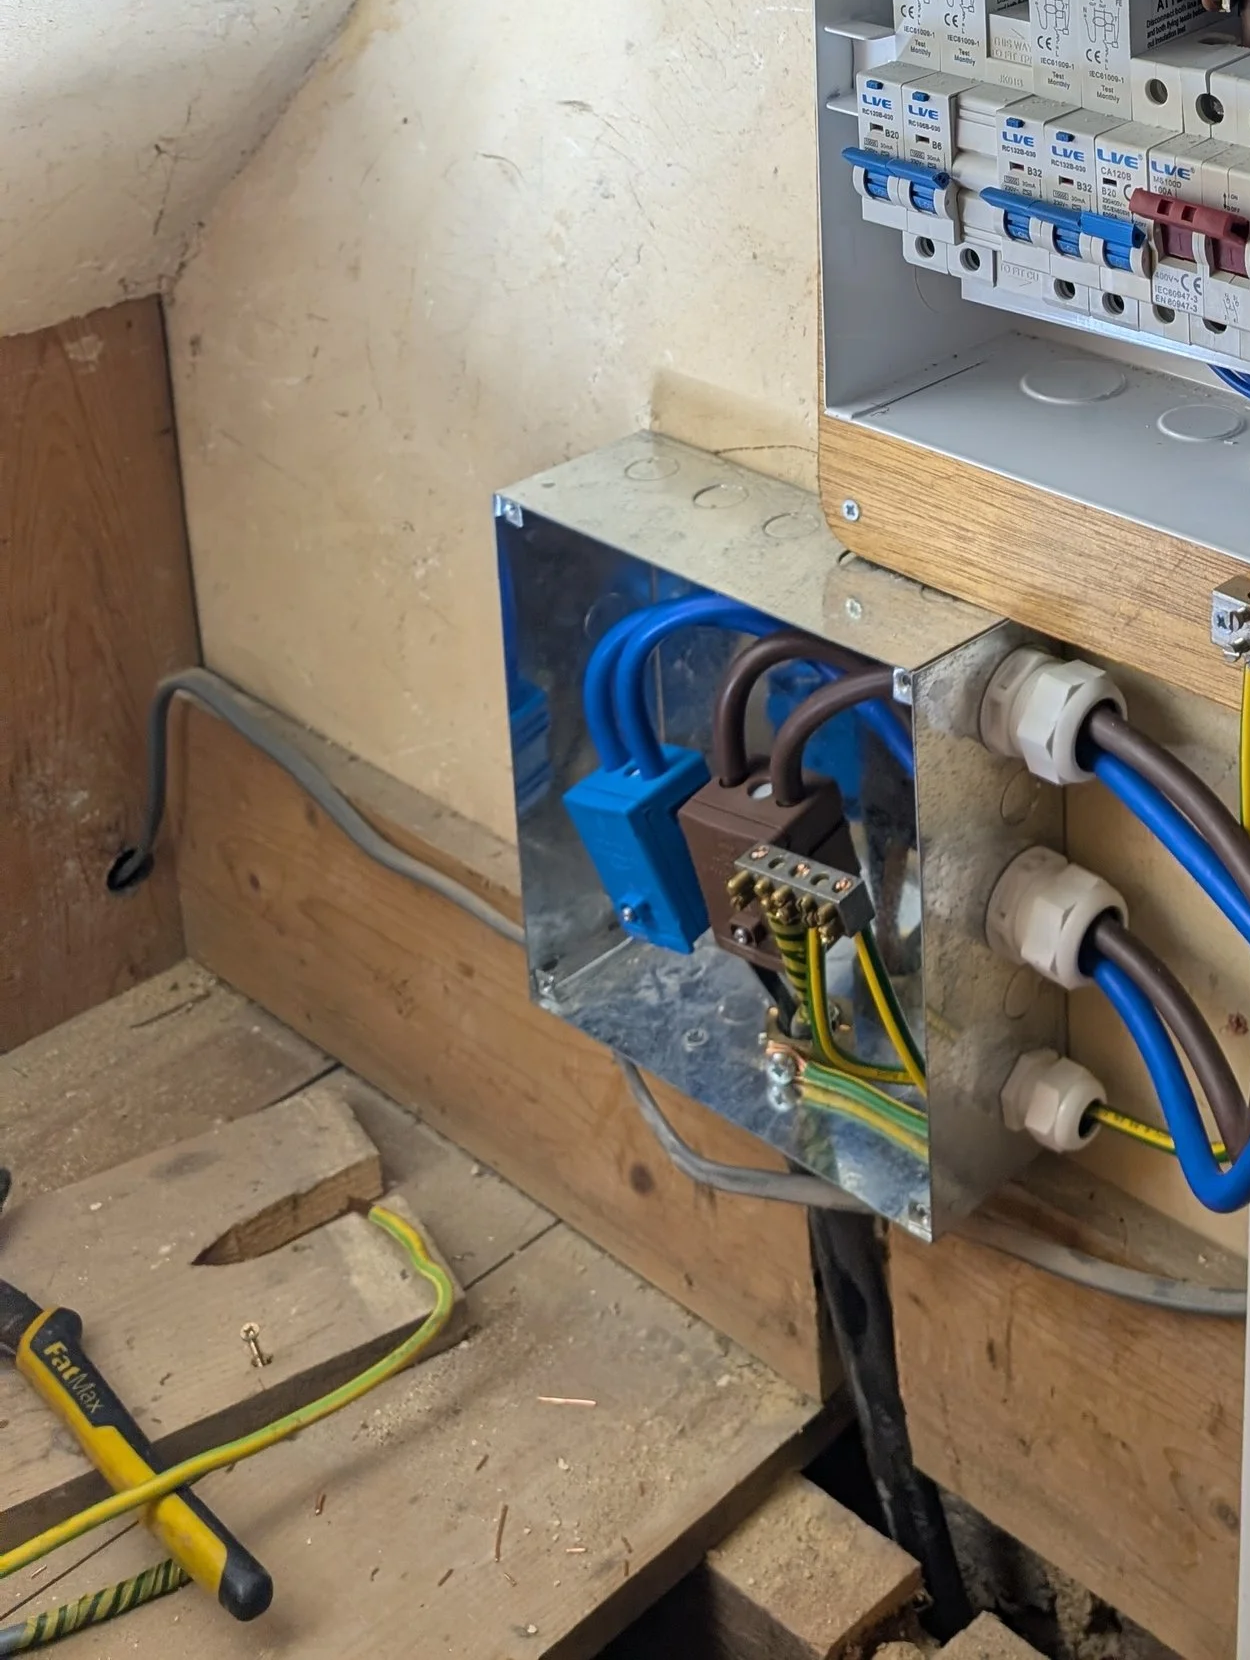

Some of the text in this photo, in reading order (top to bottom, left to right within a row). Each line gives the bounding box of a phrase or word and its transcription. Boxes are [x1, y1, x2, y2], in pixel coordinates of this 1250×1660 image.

[914, 39, 926, 48] Test
[910, 46, 932, 57] Monthly
[958, 48, 970, 57] Test
[954, 54, 976, 67] Monthly
[1052, 71, 1065, 80] Test
[1047, 78, 1071, 90] Monthly
[1101, 84, 1114, 94] Test
[1096, 91, 1120, 104] Monthly
[885, 129, 899, 140] B20
[932, 140, 942, 151] B6
[1027, 167, 1042, 178] B32
[1077, 182, 1092, 193] B32
[1102, 188, 1117, 198] B20
[1154, 186, 1173, 197] 100A
[43, 1341, 104, 1414] FatMax
